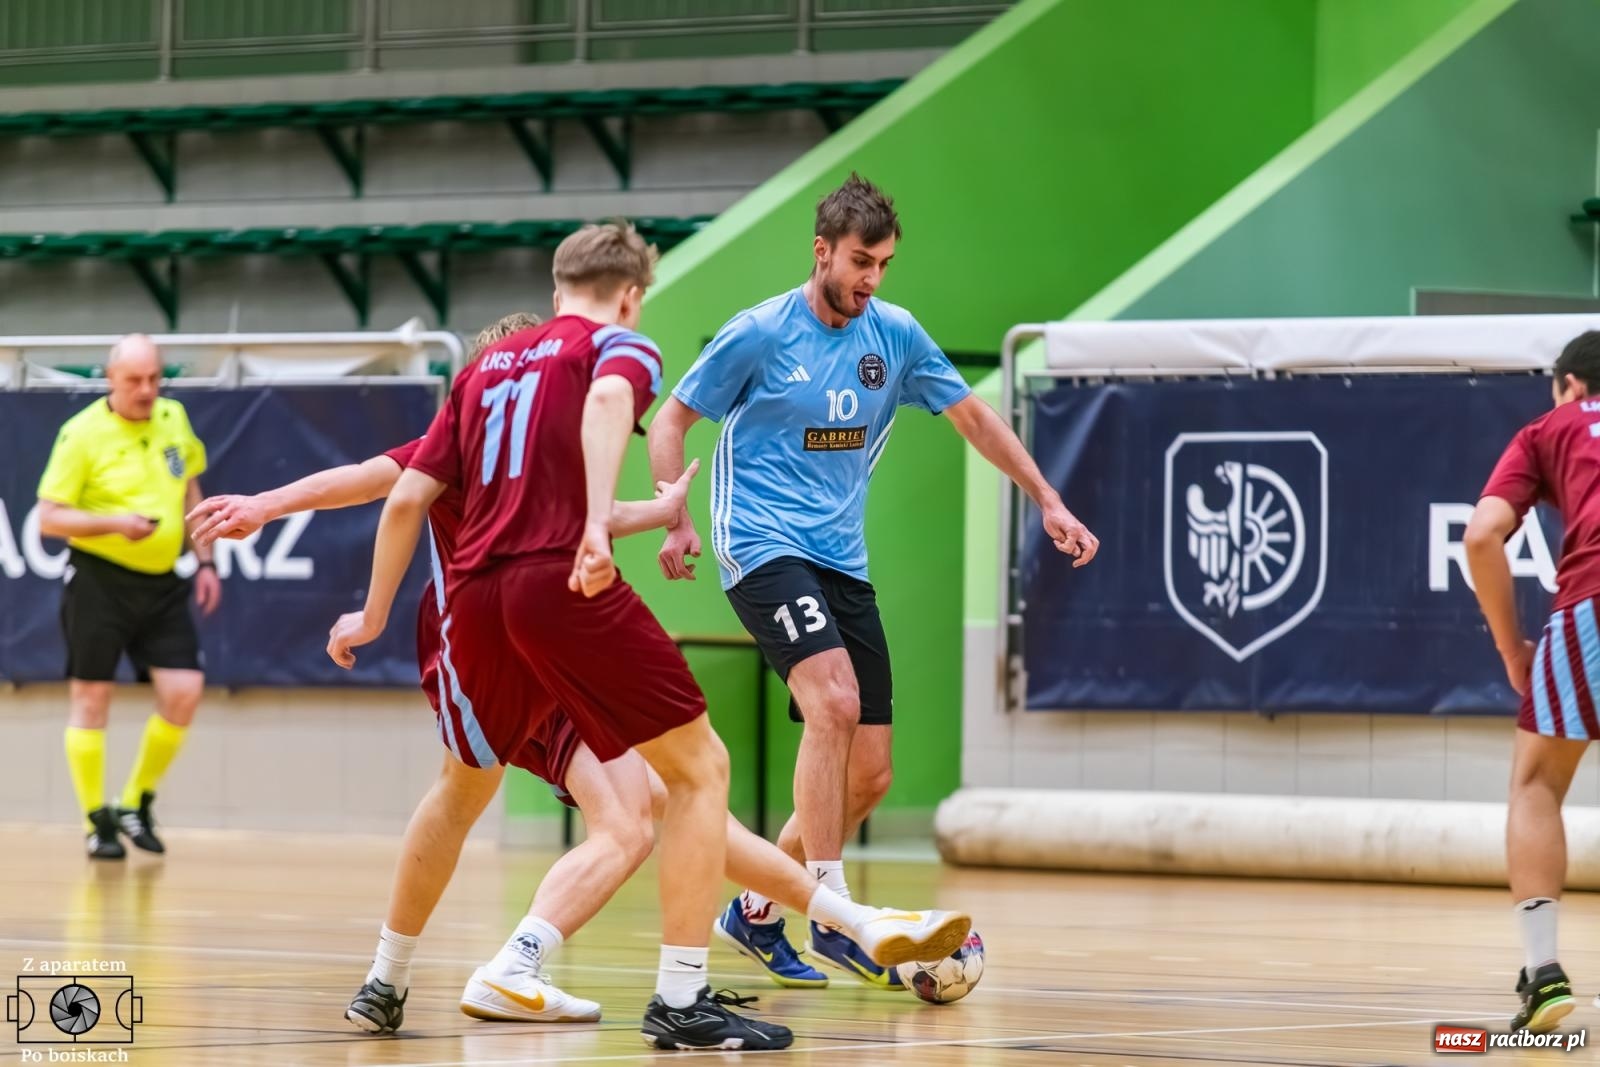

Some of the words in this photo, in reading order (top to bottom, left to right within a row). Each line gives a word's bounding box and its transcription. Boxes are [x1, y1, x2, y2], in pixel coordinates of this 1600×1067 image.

[481, 371, 541, 486] 11
[826, 389, 858, 422] 10
[773, 595, 827, 642] 13
